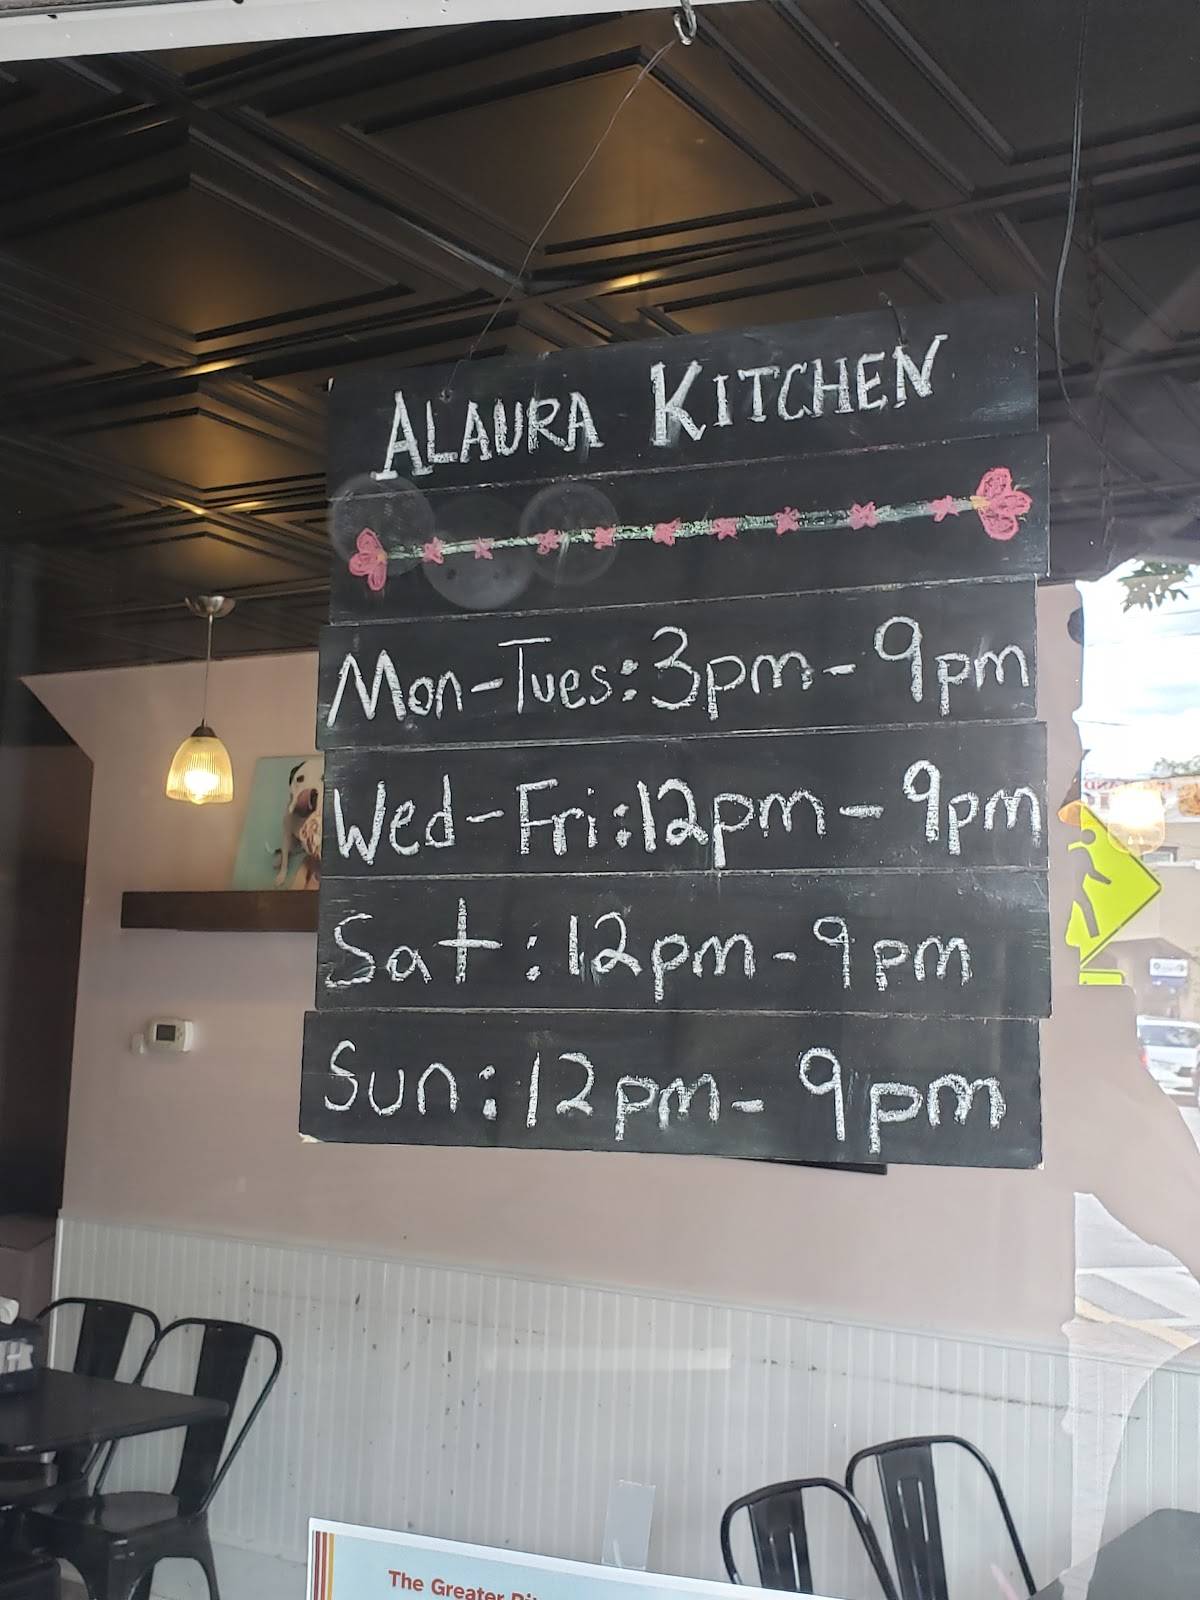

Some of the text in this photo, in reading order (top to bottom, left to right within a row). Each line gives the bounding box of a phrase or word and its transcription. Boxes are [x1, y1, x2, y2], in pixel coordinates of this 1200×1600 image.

[371, 334, 948, 481] ALAURA KITCHEN
[388, 1569, 424, 1591] The
